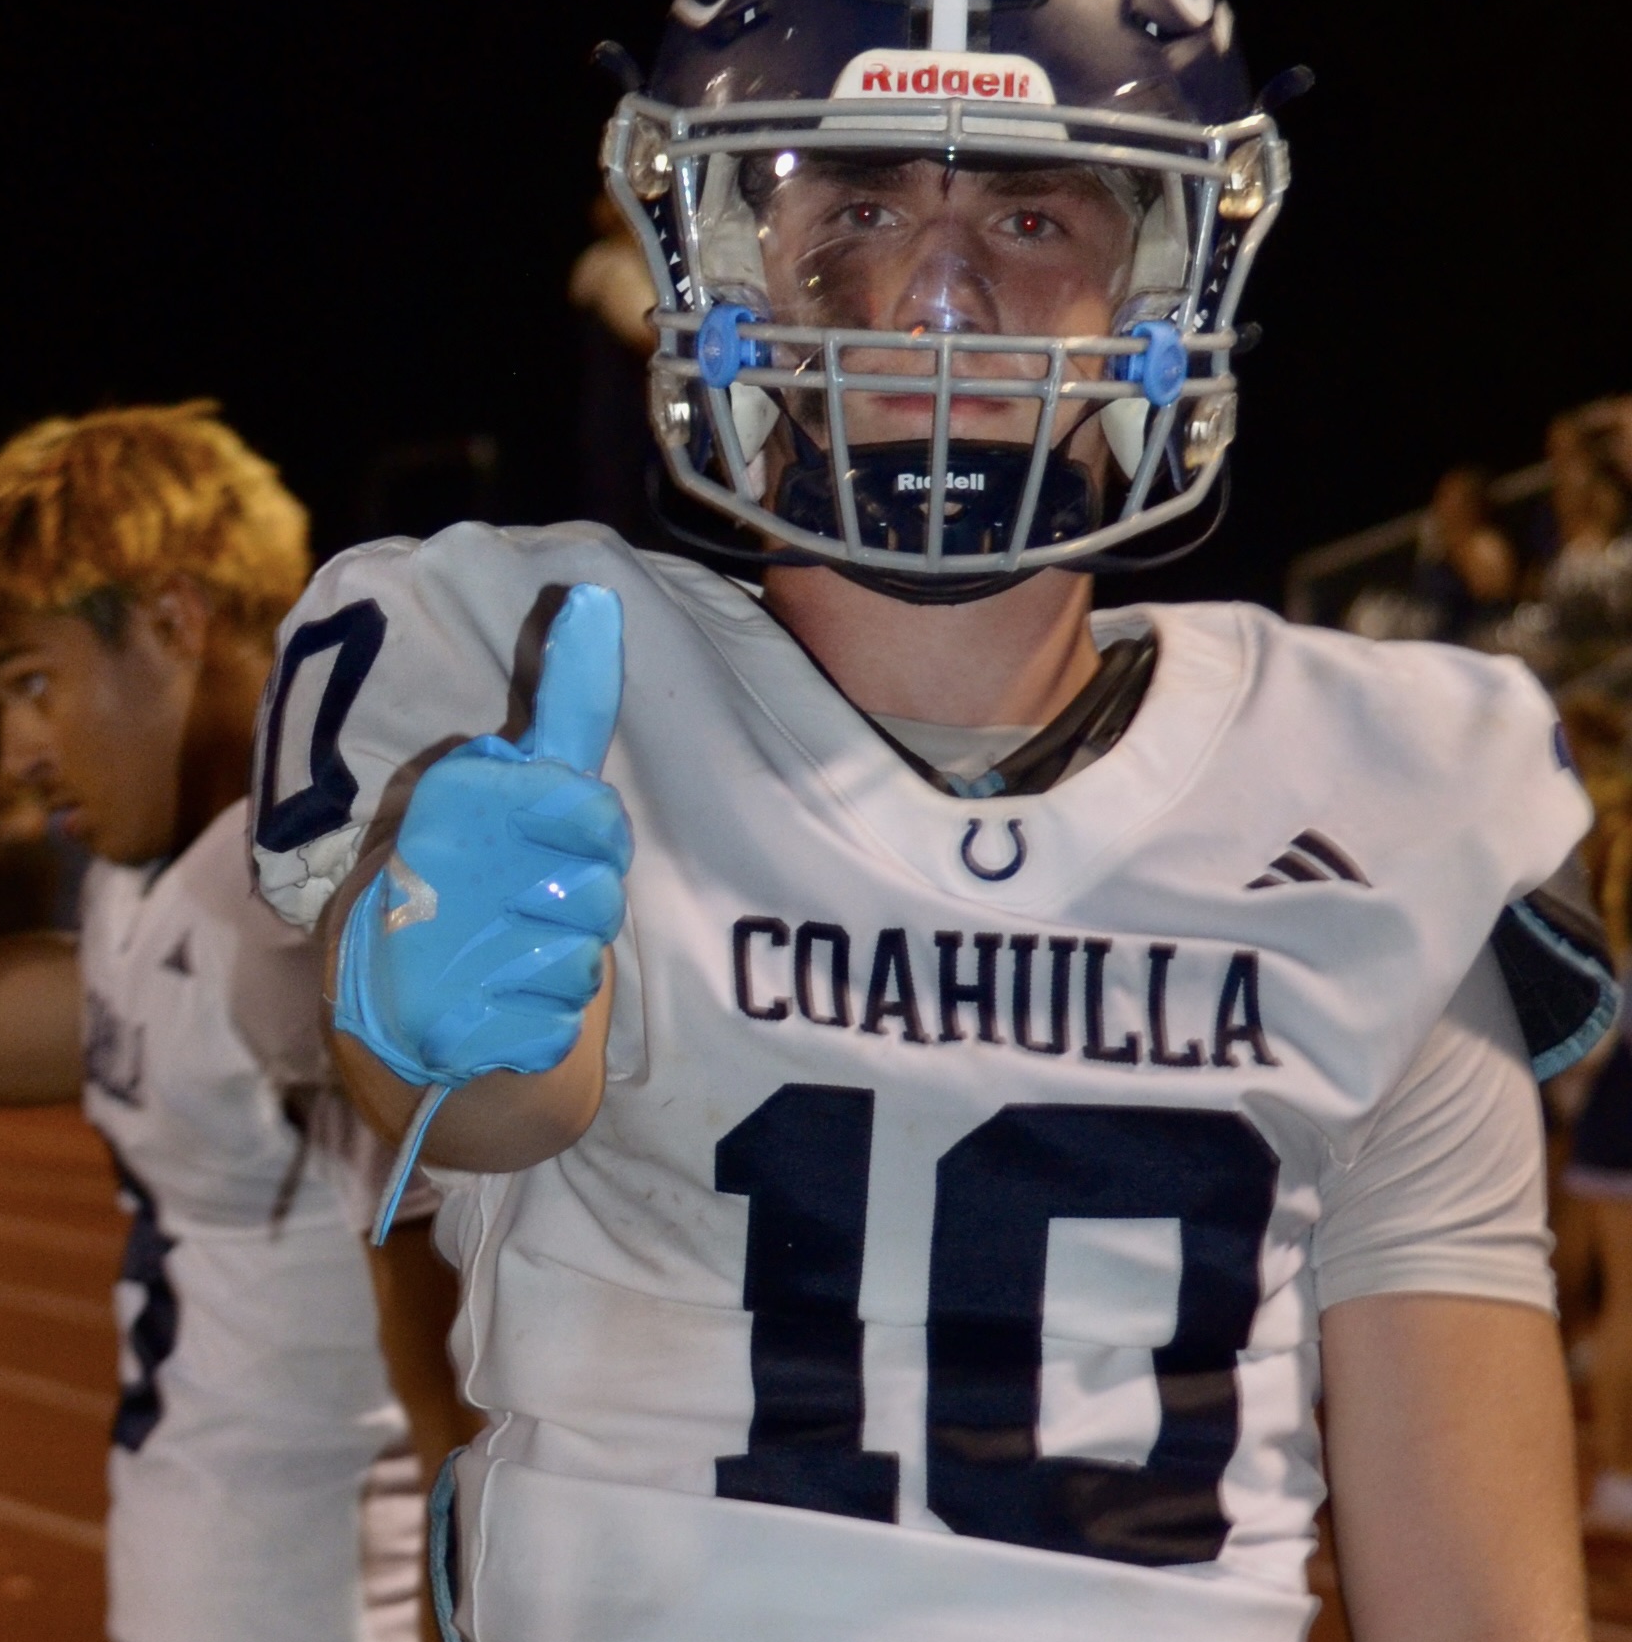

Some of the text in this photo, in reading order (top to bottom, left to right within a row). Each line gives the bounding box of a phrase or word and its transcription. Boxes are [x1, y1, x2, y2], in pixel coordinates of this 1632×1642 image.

[862, 63, 1030, 98] Riddell
[732, 915, 1282, 1067] COAHULLA
[715, 1083, 1280, 1566] 10
